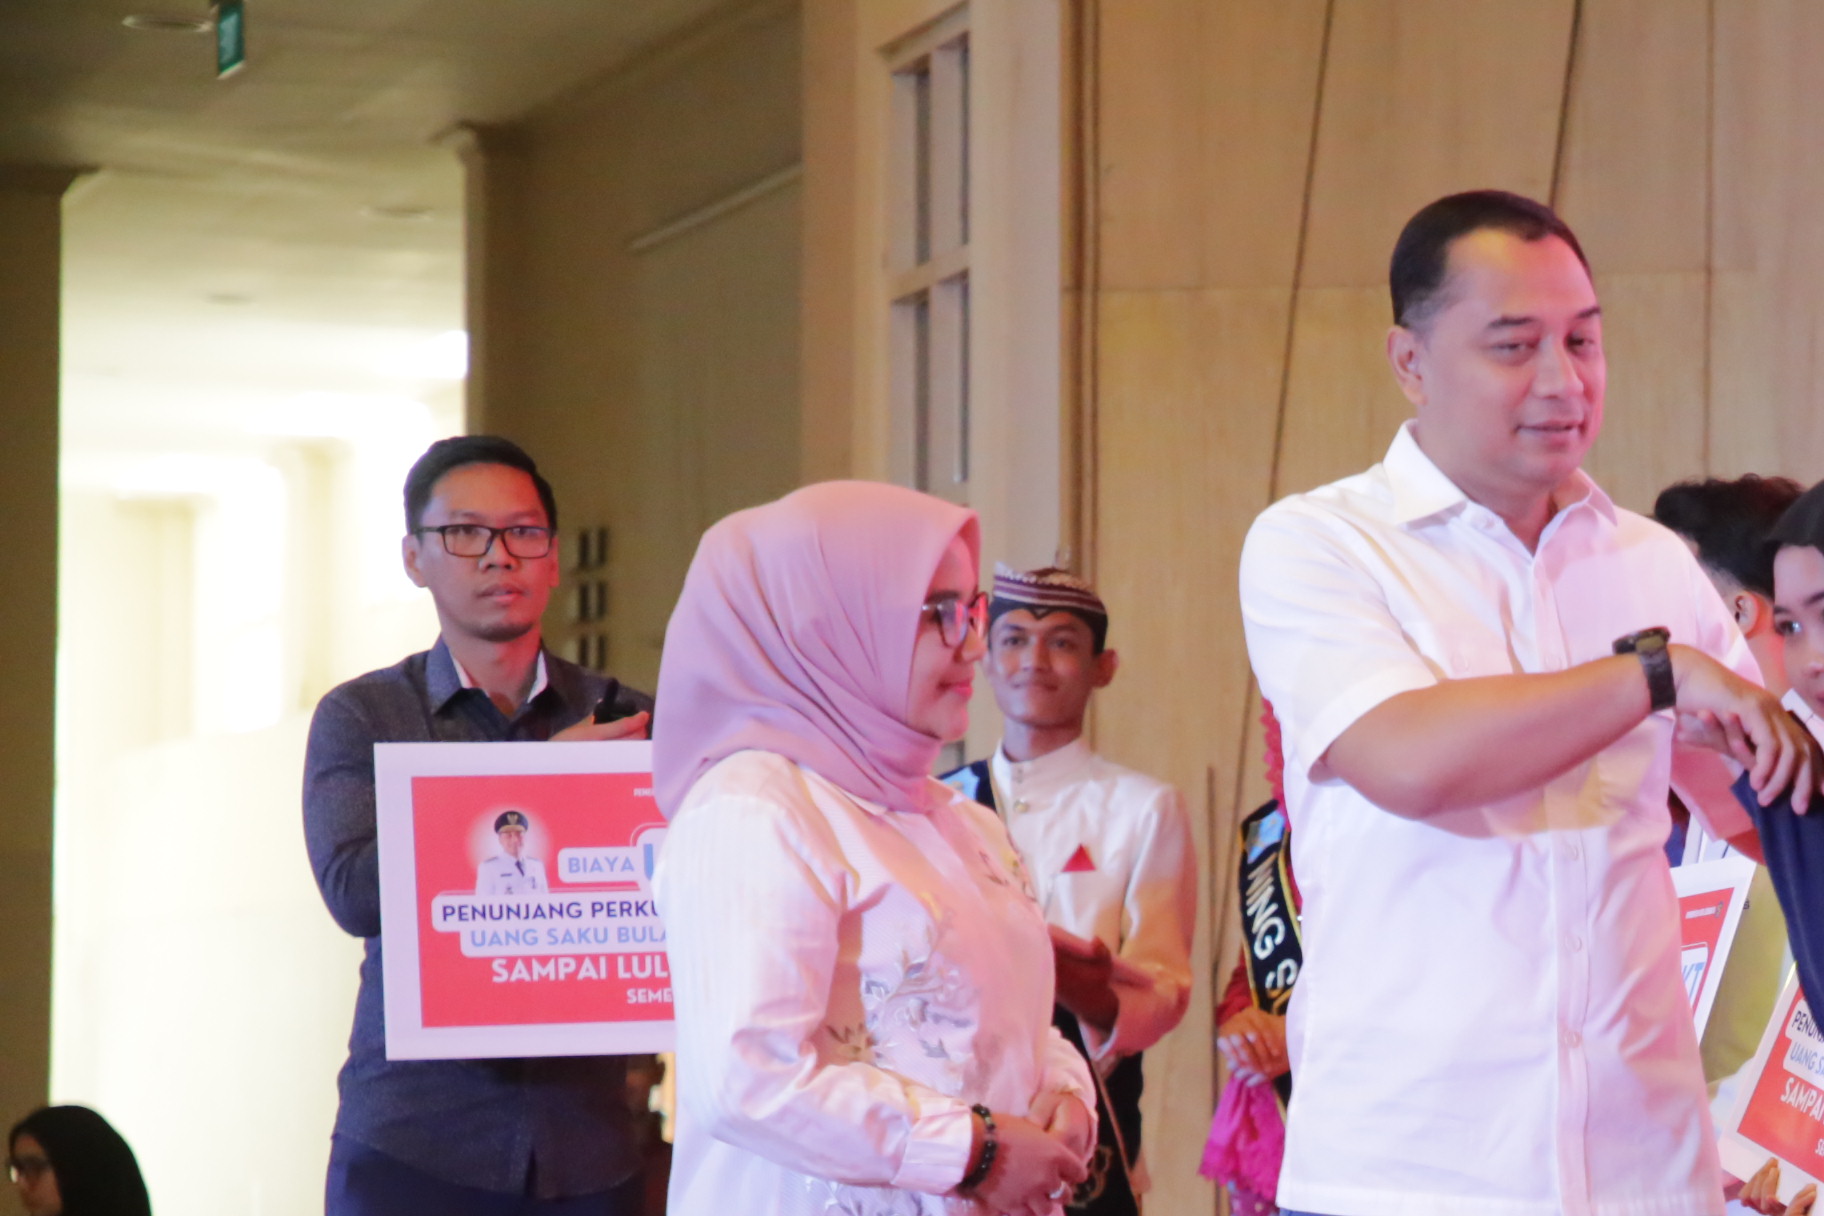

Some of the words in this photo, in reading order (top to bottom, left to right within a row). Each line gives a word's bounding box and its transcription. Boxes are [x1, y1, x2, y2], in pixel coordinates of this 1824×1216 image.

[567, 856, 635, 873] BIAYA
[442, 902, 583, 922] PENUNJANG
[470, 928, 539, 947] UANG
[546, 927, 609, 946] SAKU
[491, 956, 607, 983] SAMPAI
[1790, 1042, 1818, 1070] UANG
